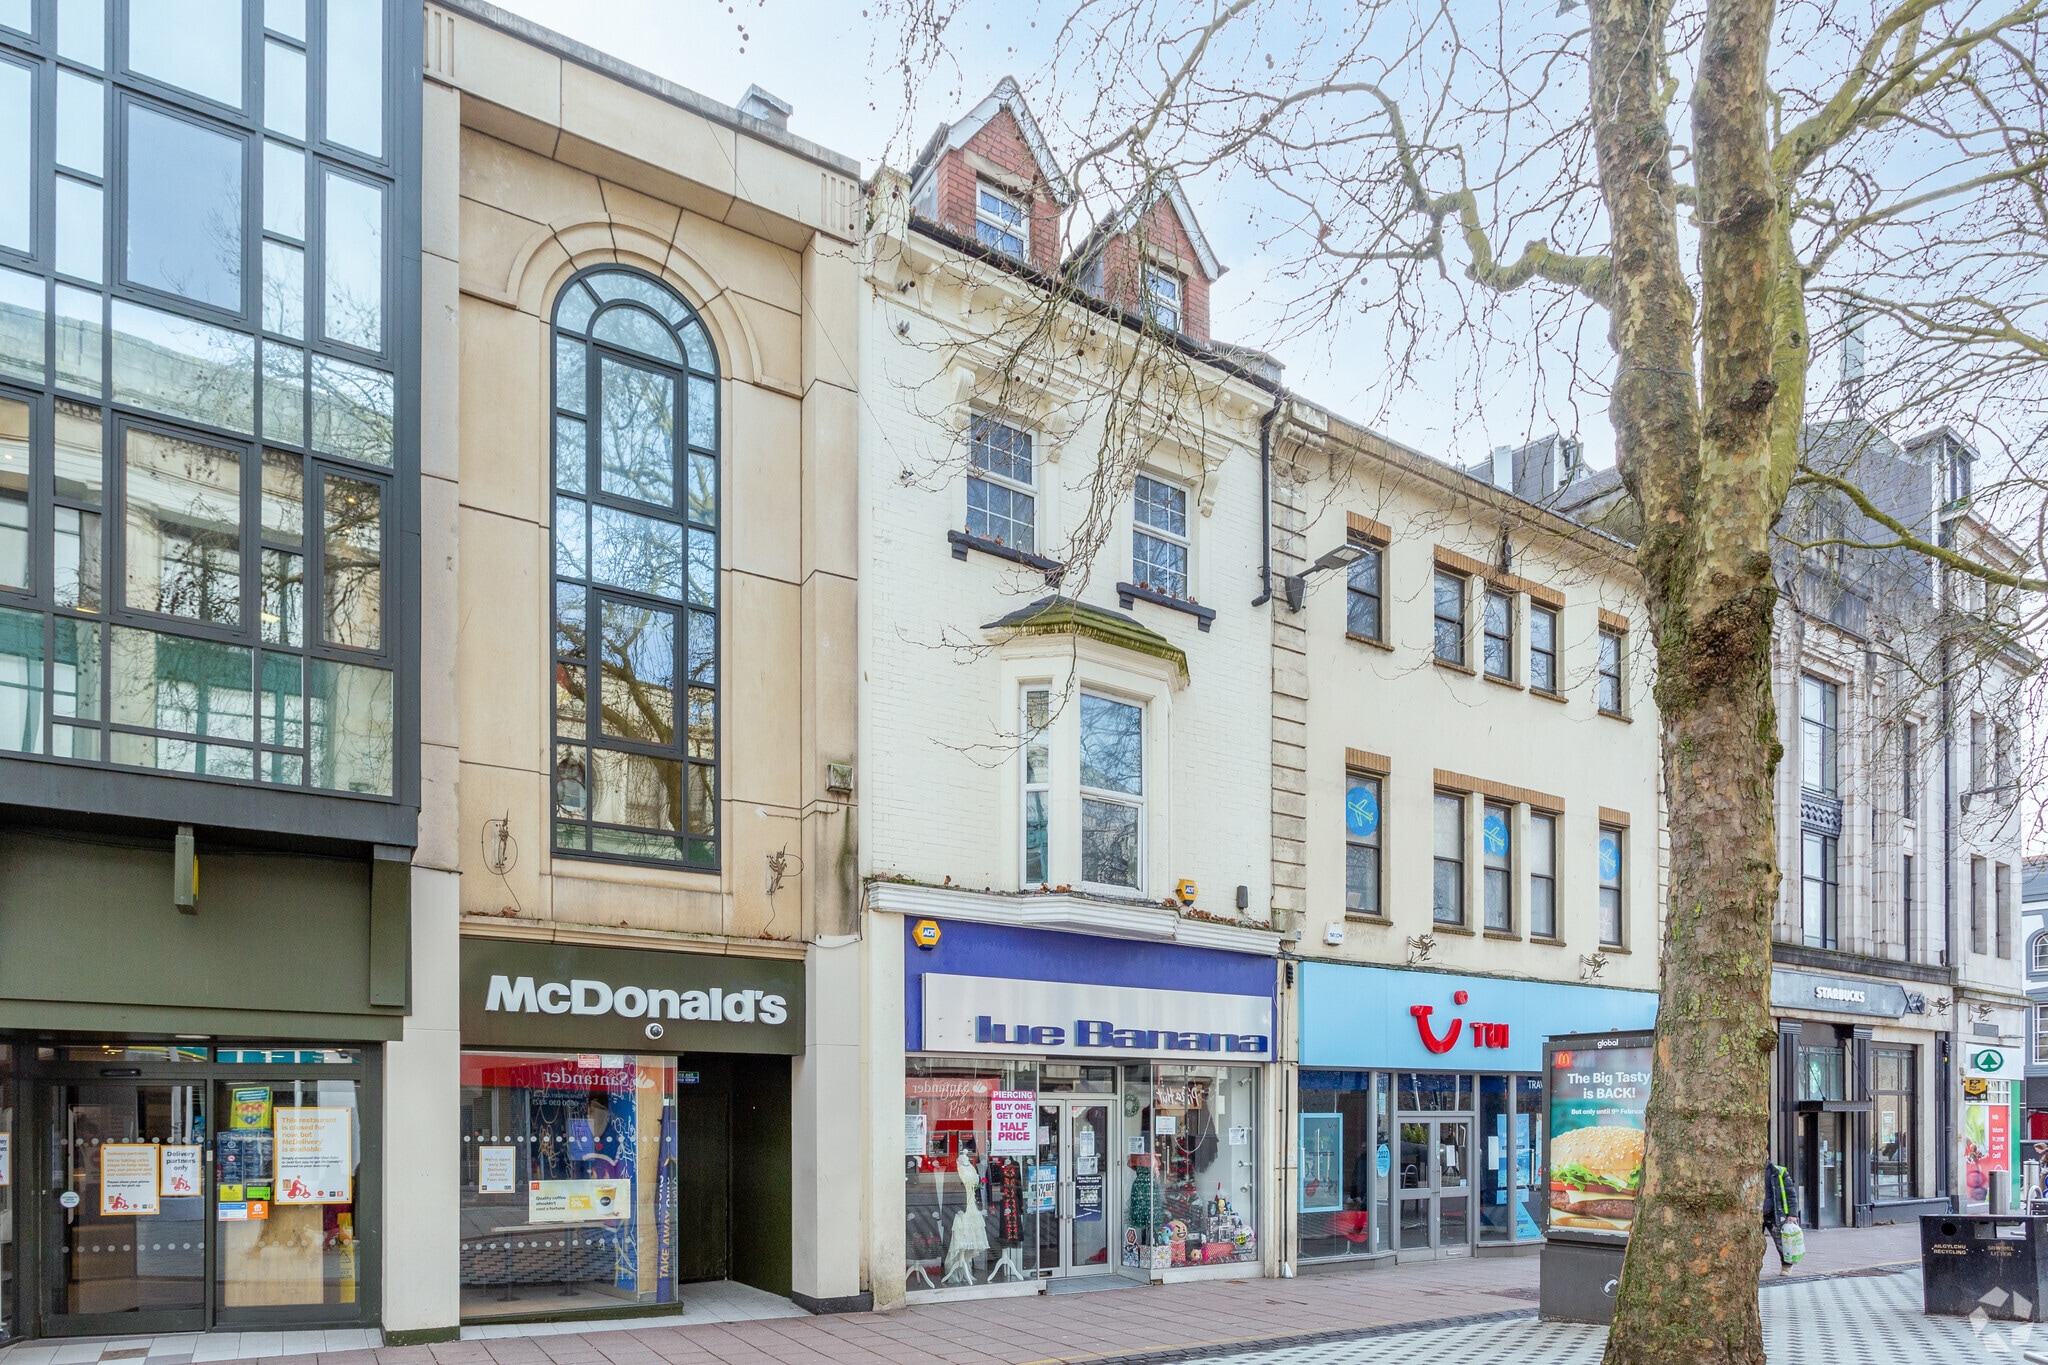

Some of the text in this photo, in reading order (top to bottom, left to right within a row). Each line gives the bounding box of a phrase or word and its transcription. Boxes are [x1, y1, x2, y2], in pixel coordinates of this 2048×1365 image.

[923, 928, 935, 937] ADT
[1815, 986, 1865, 1002] STARBUCKS
[485, 975, 787, 1025] McDonald's
[1074, 1020, 1268, 1053] Banana
[1470, 1022, 1509, 1049] TUI
[1597, 1039, 1618, 1049] global
[1567, 1071, 1651, 1085] The Big Tasty
[993, 1091, 1033, 1099] PIERCING
[1583, 1088, 1635, 1099] is BACK!
[995, 1103, 1034, 1112] BUY ONE,
[1000, 1122, 1028, 1131] HALF
[998, 1132, 1030, 1141] PRICE
[660, 1247, 670, 1278] TAKE
